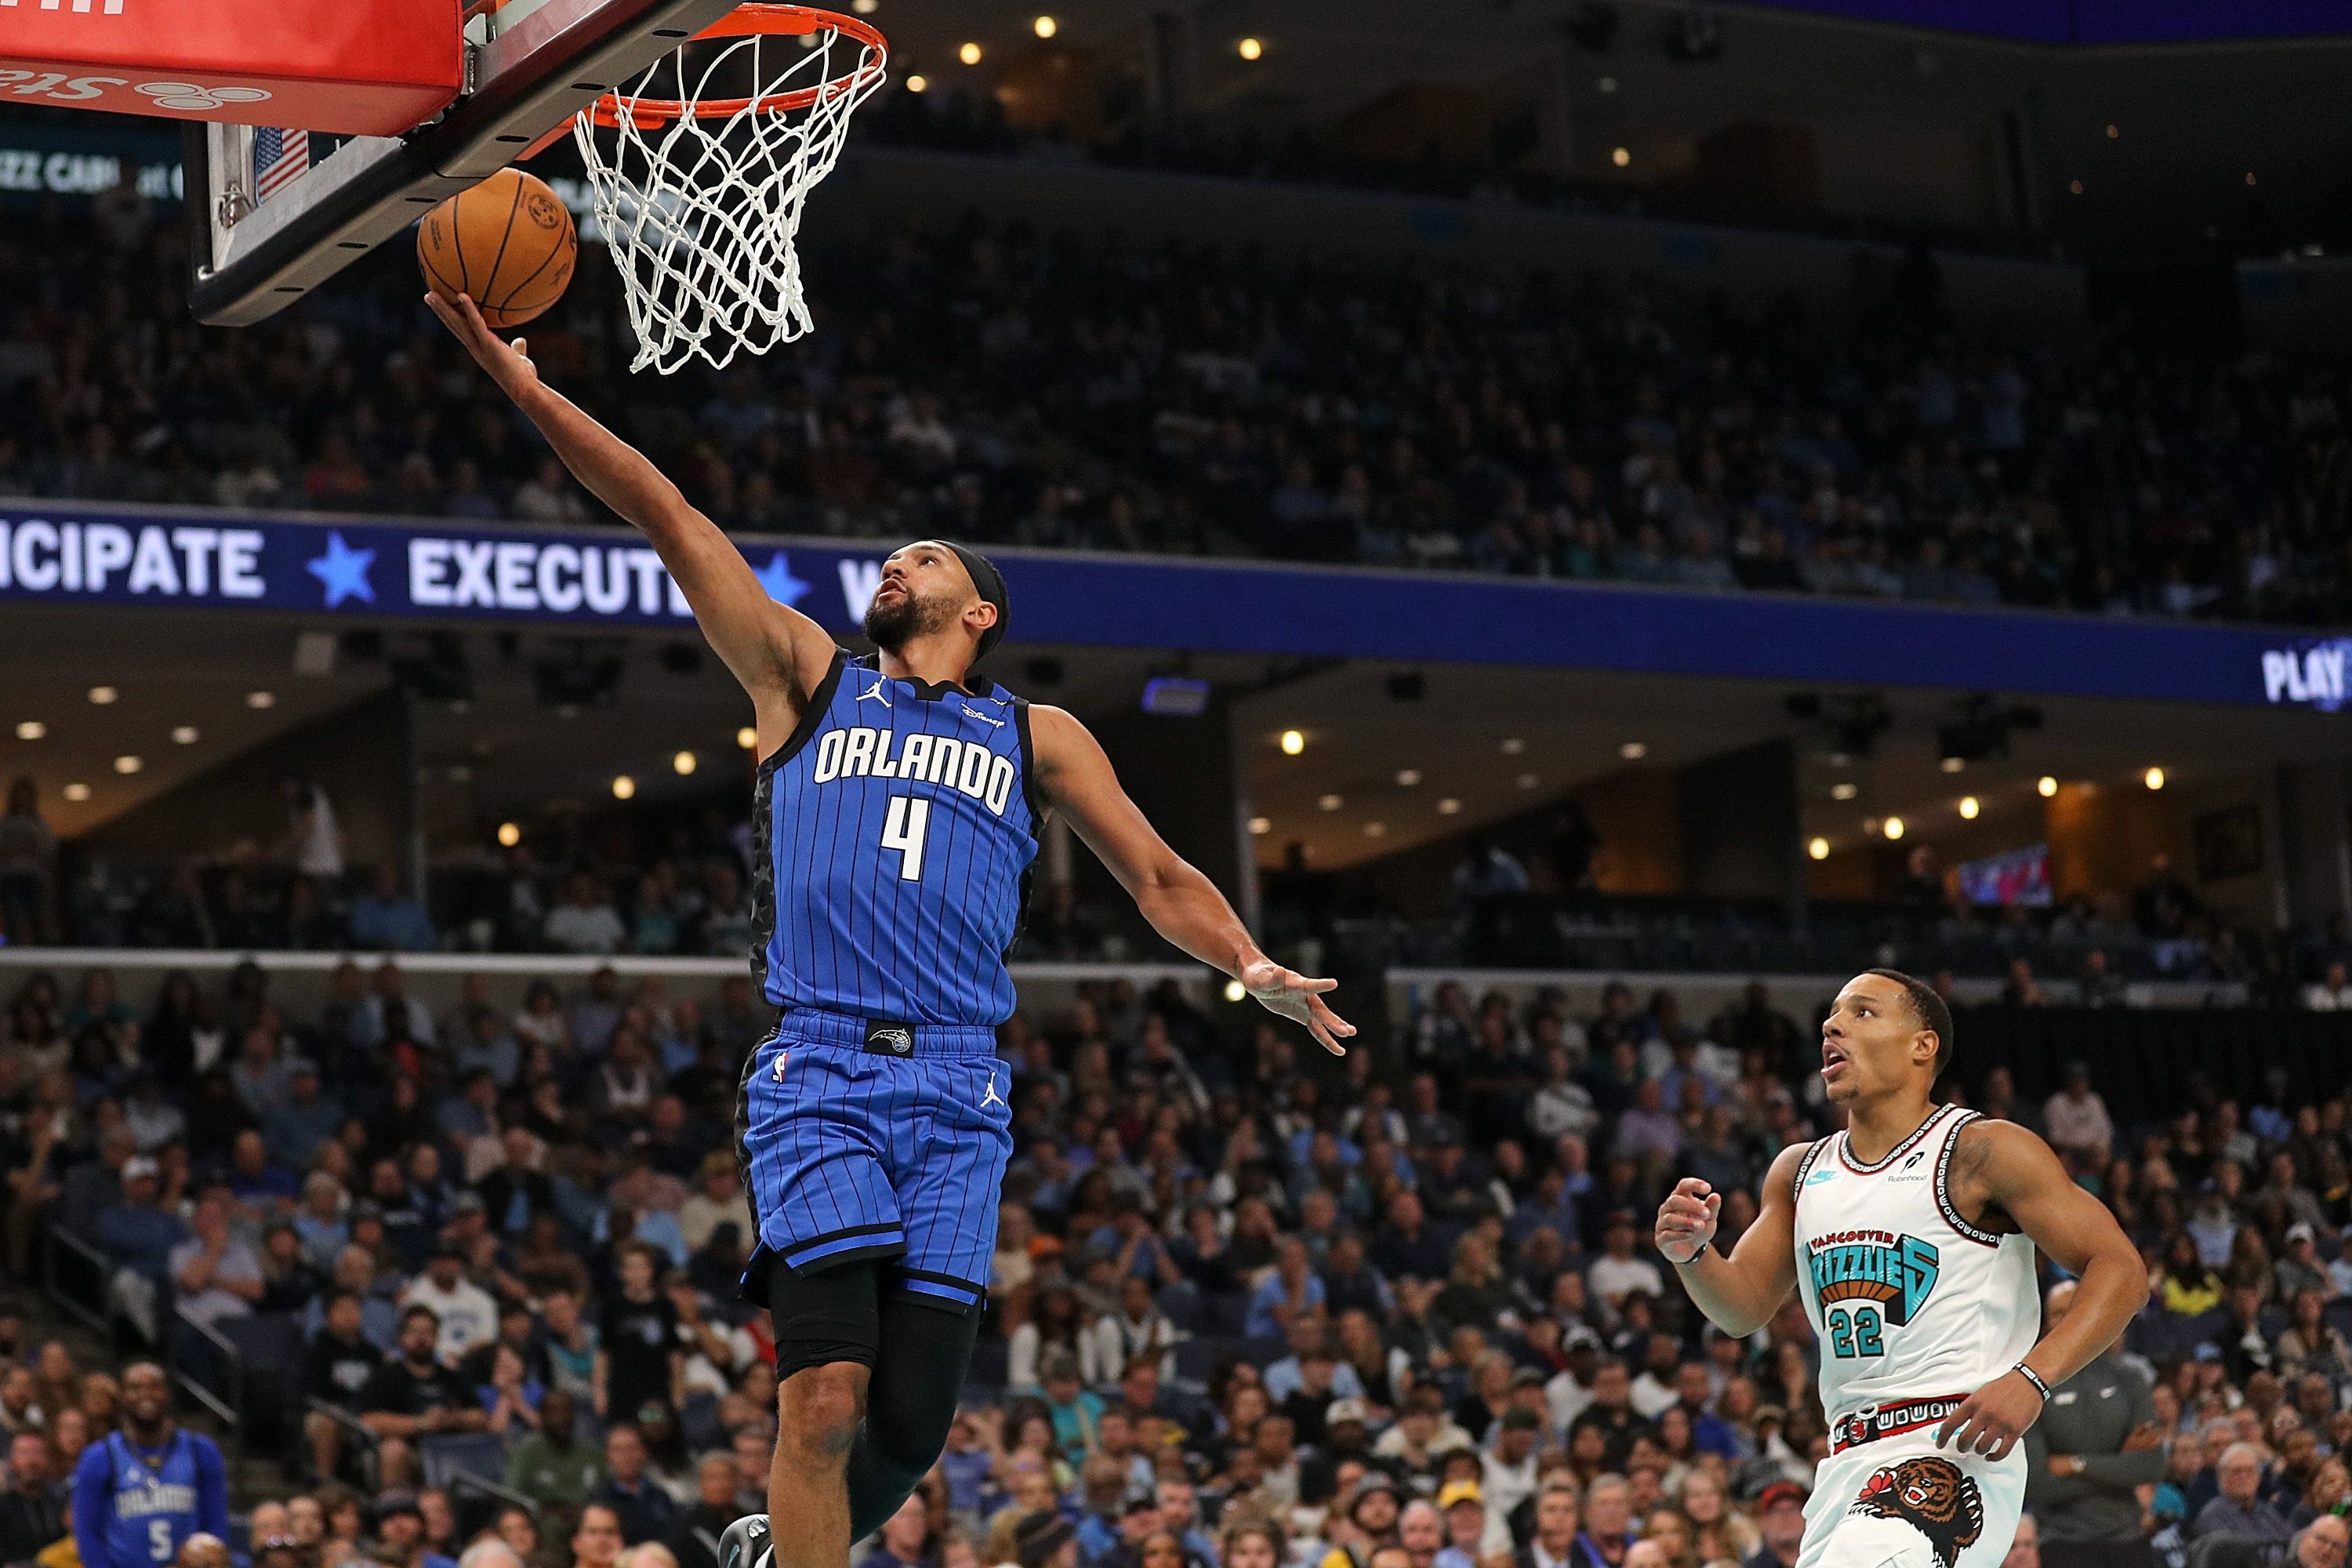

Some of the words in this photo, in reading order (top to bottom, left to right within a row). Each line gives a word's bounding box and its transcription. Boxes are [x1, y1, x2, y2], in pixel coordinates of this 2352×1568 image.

[2261, 650, 2345, 702] PLAY
[813, 726, 1016, 817] ORLANDO
[880, 795, 930, 882] 4
[1887, 1174, 1928, 1183] Robinhood
[1810, 1229, 1894, 1250] VANCOUVER
[1829, 1306, 1885, 1358] 22
[148, 1519, 171, 1561] 5
